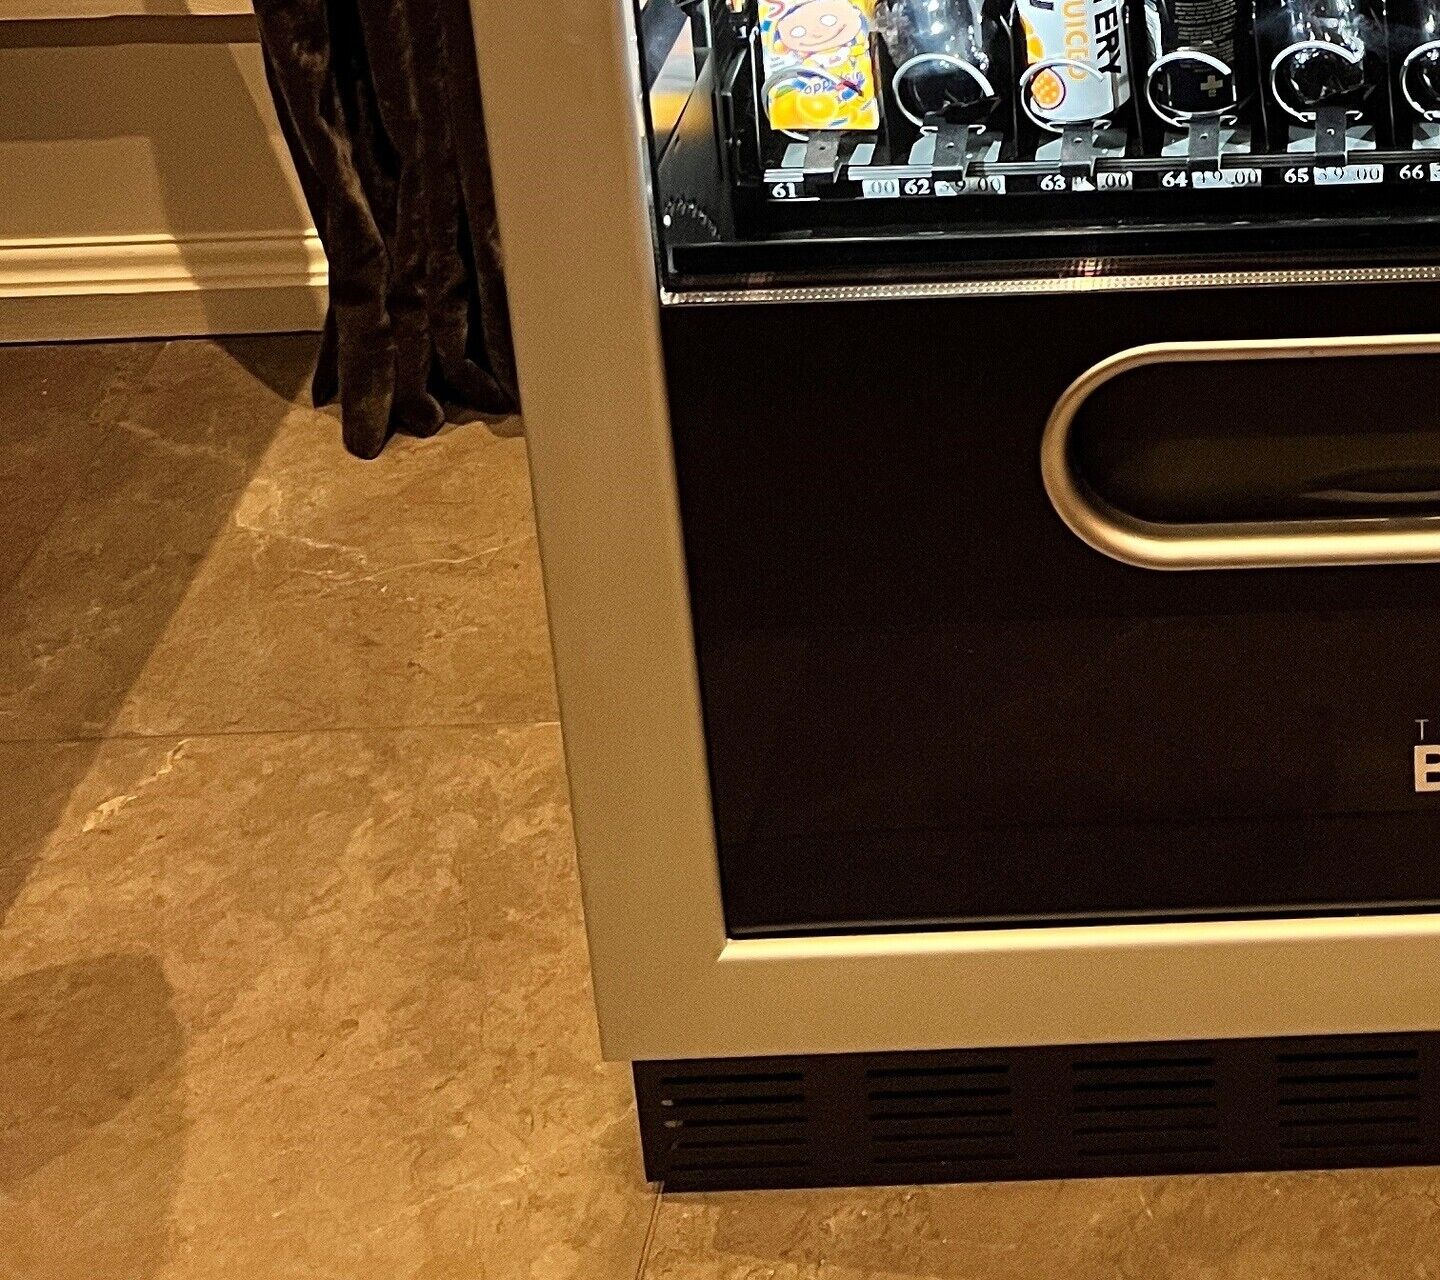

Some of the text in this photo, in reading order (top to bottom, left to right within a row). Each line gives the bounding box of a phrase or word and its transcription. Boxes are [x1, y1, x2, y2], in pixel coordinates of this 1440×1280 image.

[1161, 171, 1188, 187] 64
[1284, 168, 1309, 184] 65
[1399, 164, 1425, 181] 66
[904, 178, 931, 195] 62
[1040, 174, 1066, 191] 63
[771, 183, 798, 199] 61
